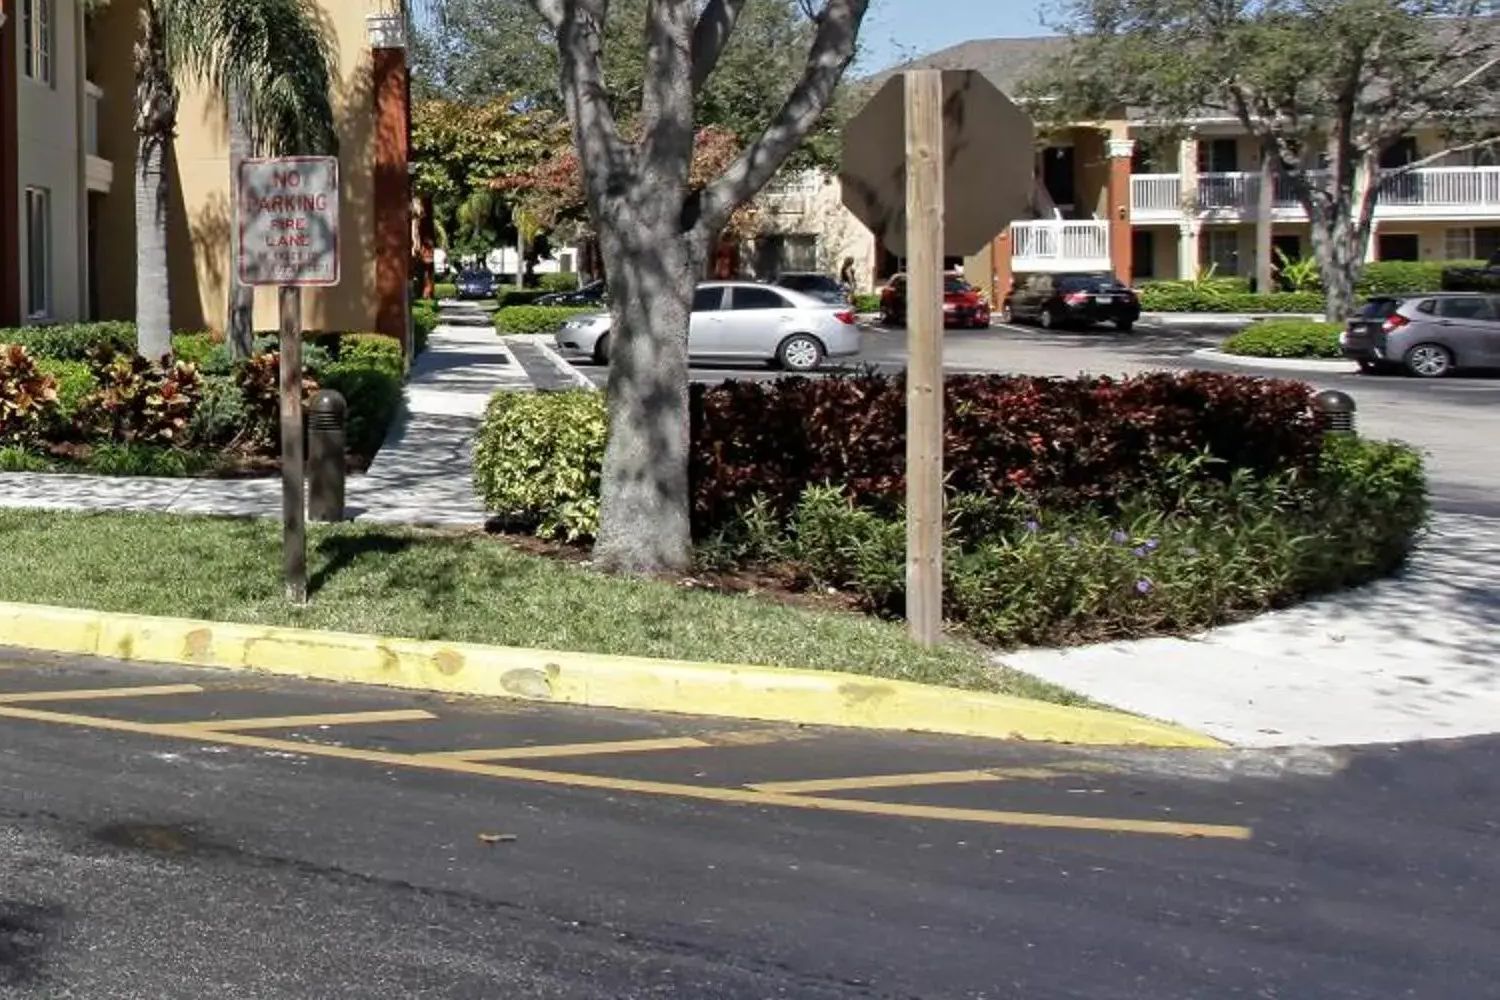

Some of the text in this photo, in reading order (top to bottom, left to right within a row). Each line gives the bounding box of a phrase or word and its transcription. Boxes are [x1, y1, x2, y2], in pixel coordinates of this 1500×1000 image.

[272, 170, 300, 188] NO
[248, 193, 327, 212] PARKING
[271, 218, 308, 230] FIRE
[265, 235, 310, 247] LANE
